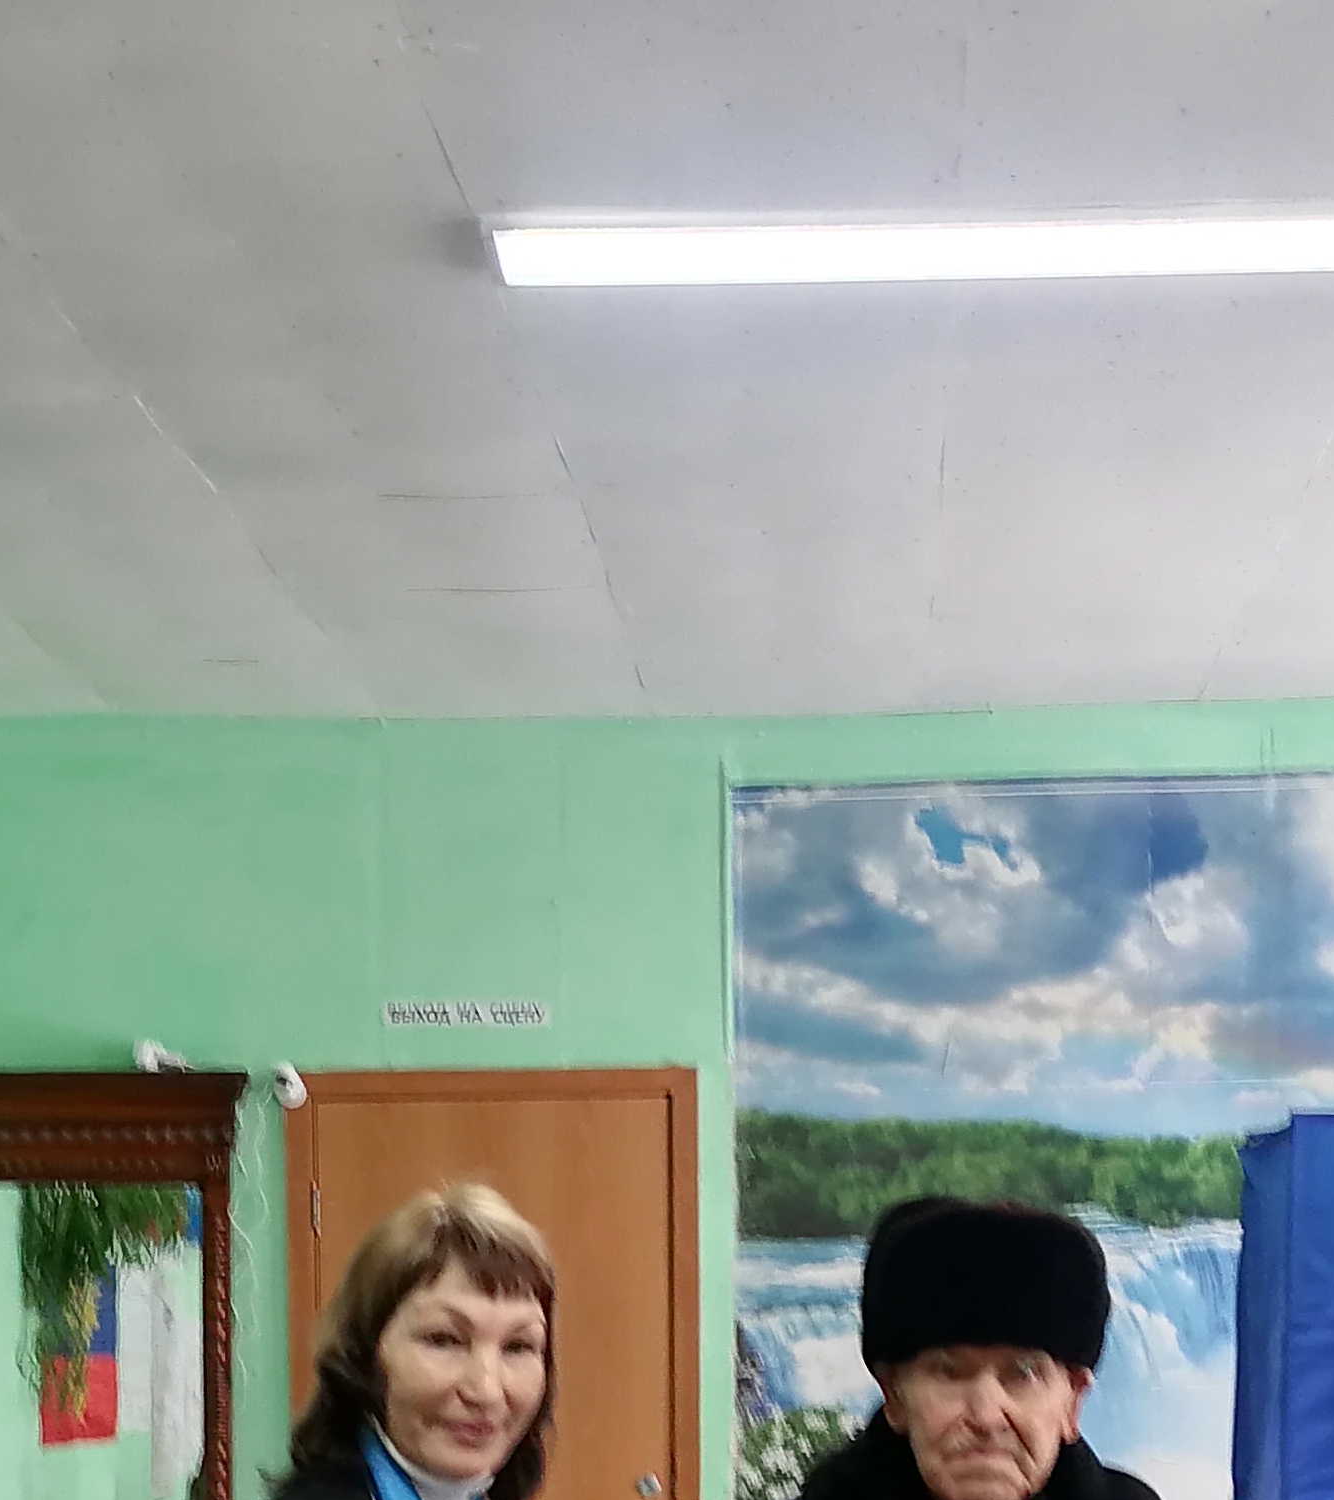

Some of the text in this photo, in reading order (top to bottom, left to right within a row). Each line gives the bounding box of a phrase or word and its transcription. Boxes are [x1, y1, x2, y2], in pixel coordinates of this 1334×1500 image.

[387, 1003, 546, 1026] ВЫХОД НА СЦЕНУ
